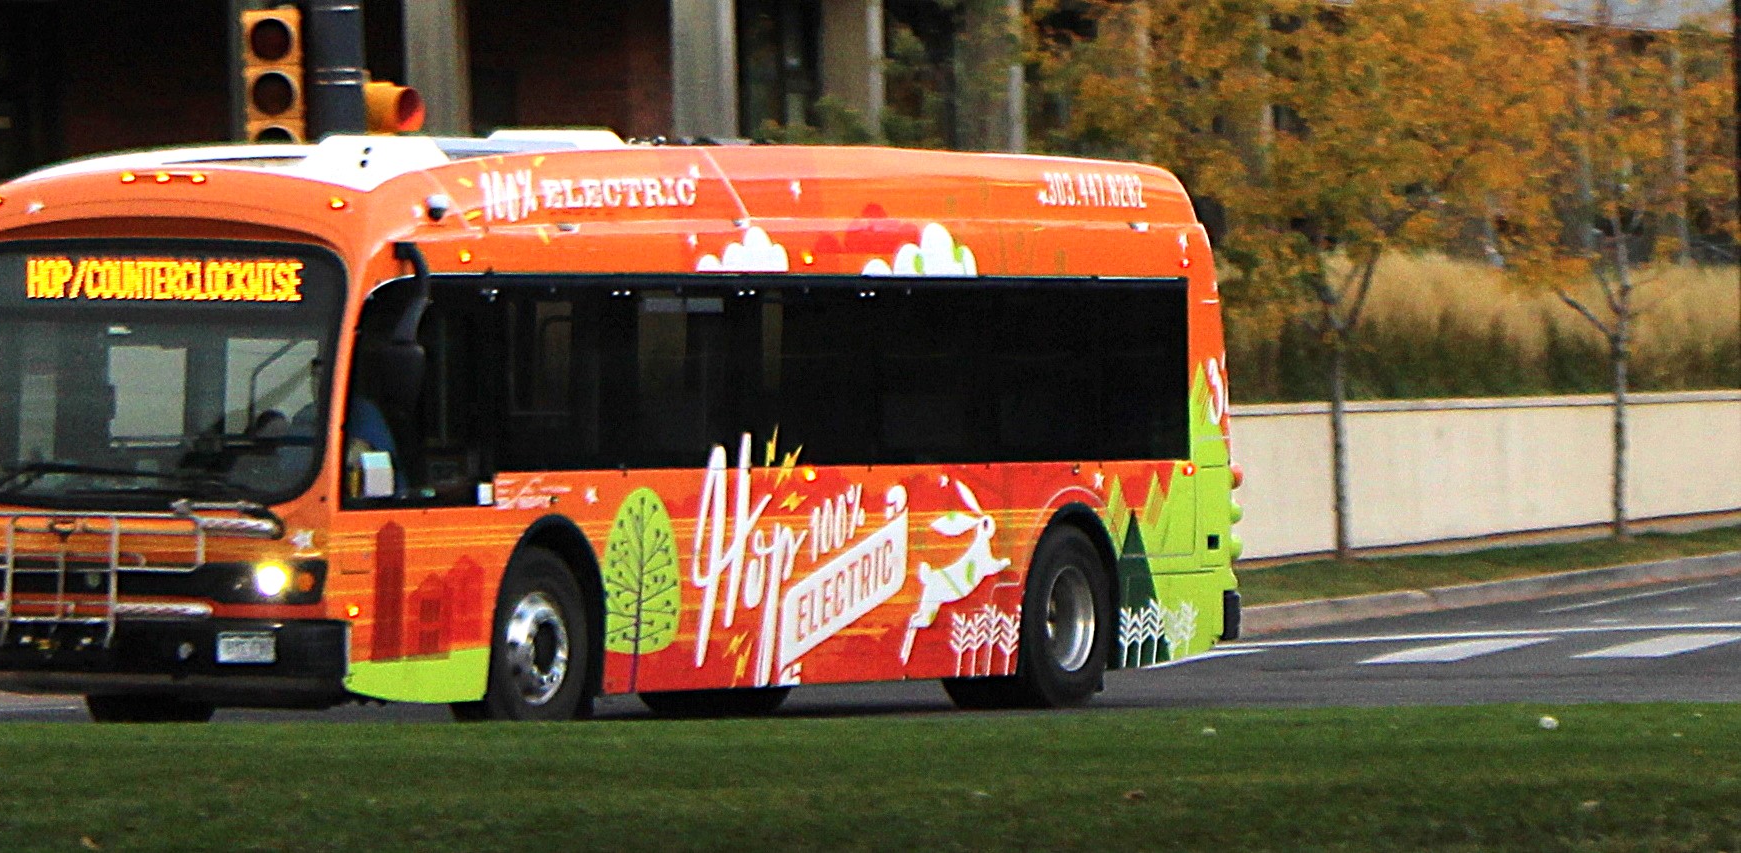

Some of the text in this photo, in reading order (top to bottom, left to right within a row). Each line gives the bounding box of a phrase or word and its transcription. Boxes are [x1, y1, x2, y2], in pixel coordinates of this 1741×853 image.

[480, 169, 697, 222] 100% ELECTRIC
[26, 257, 303, 301] HOP/COUNTERCLOCKWISE
[692, 432, 808, 688] Hop
[811, 483, 866, 563] 100%
[796, 538, 894, 642] ELECTRIC
